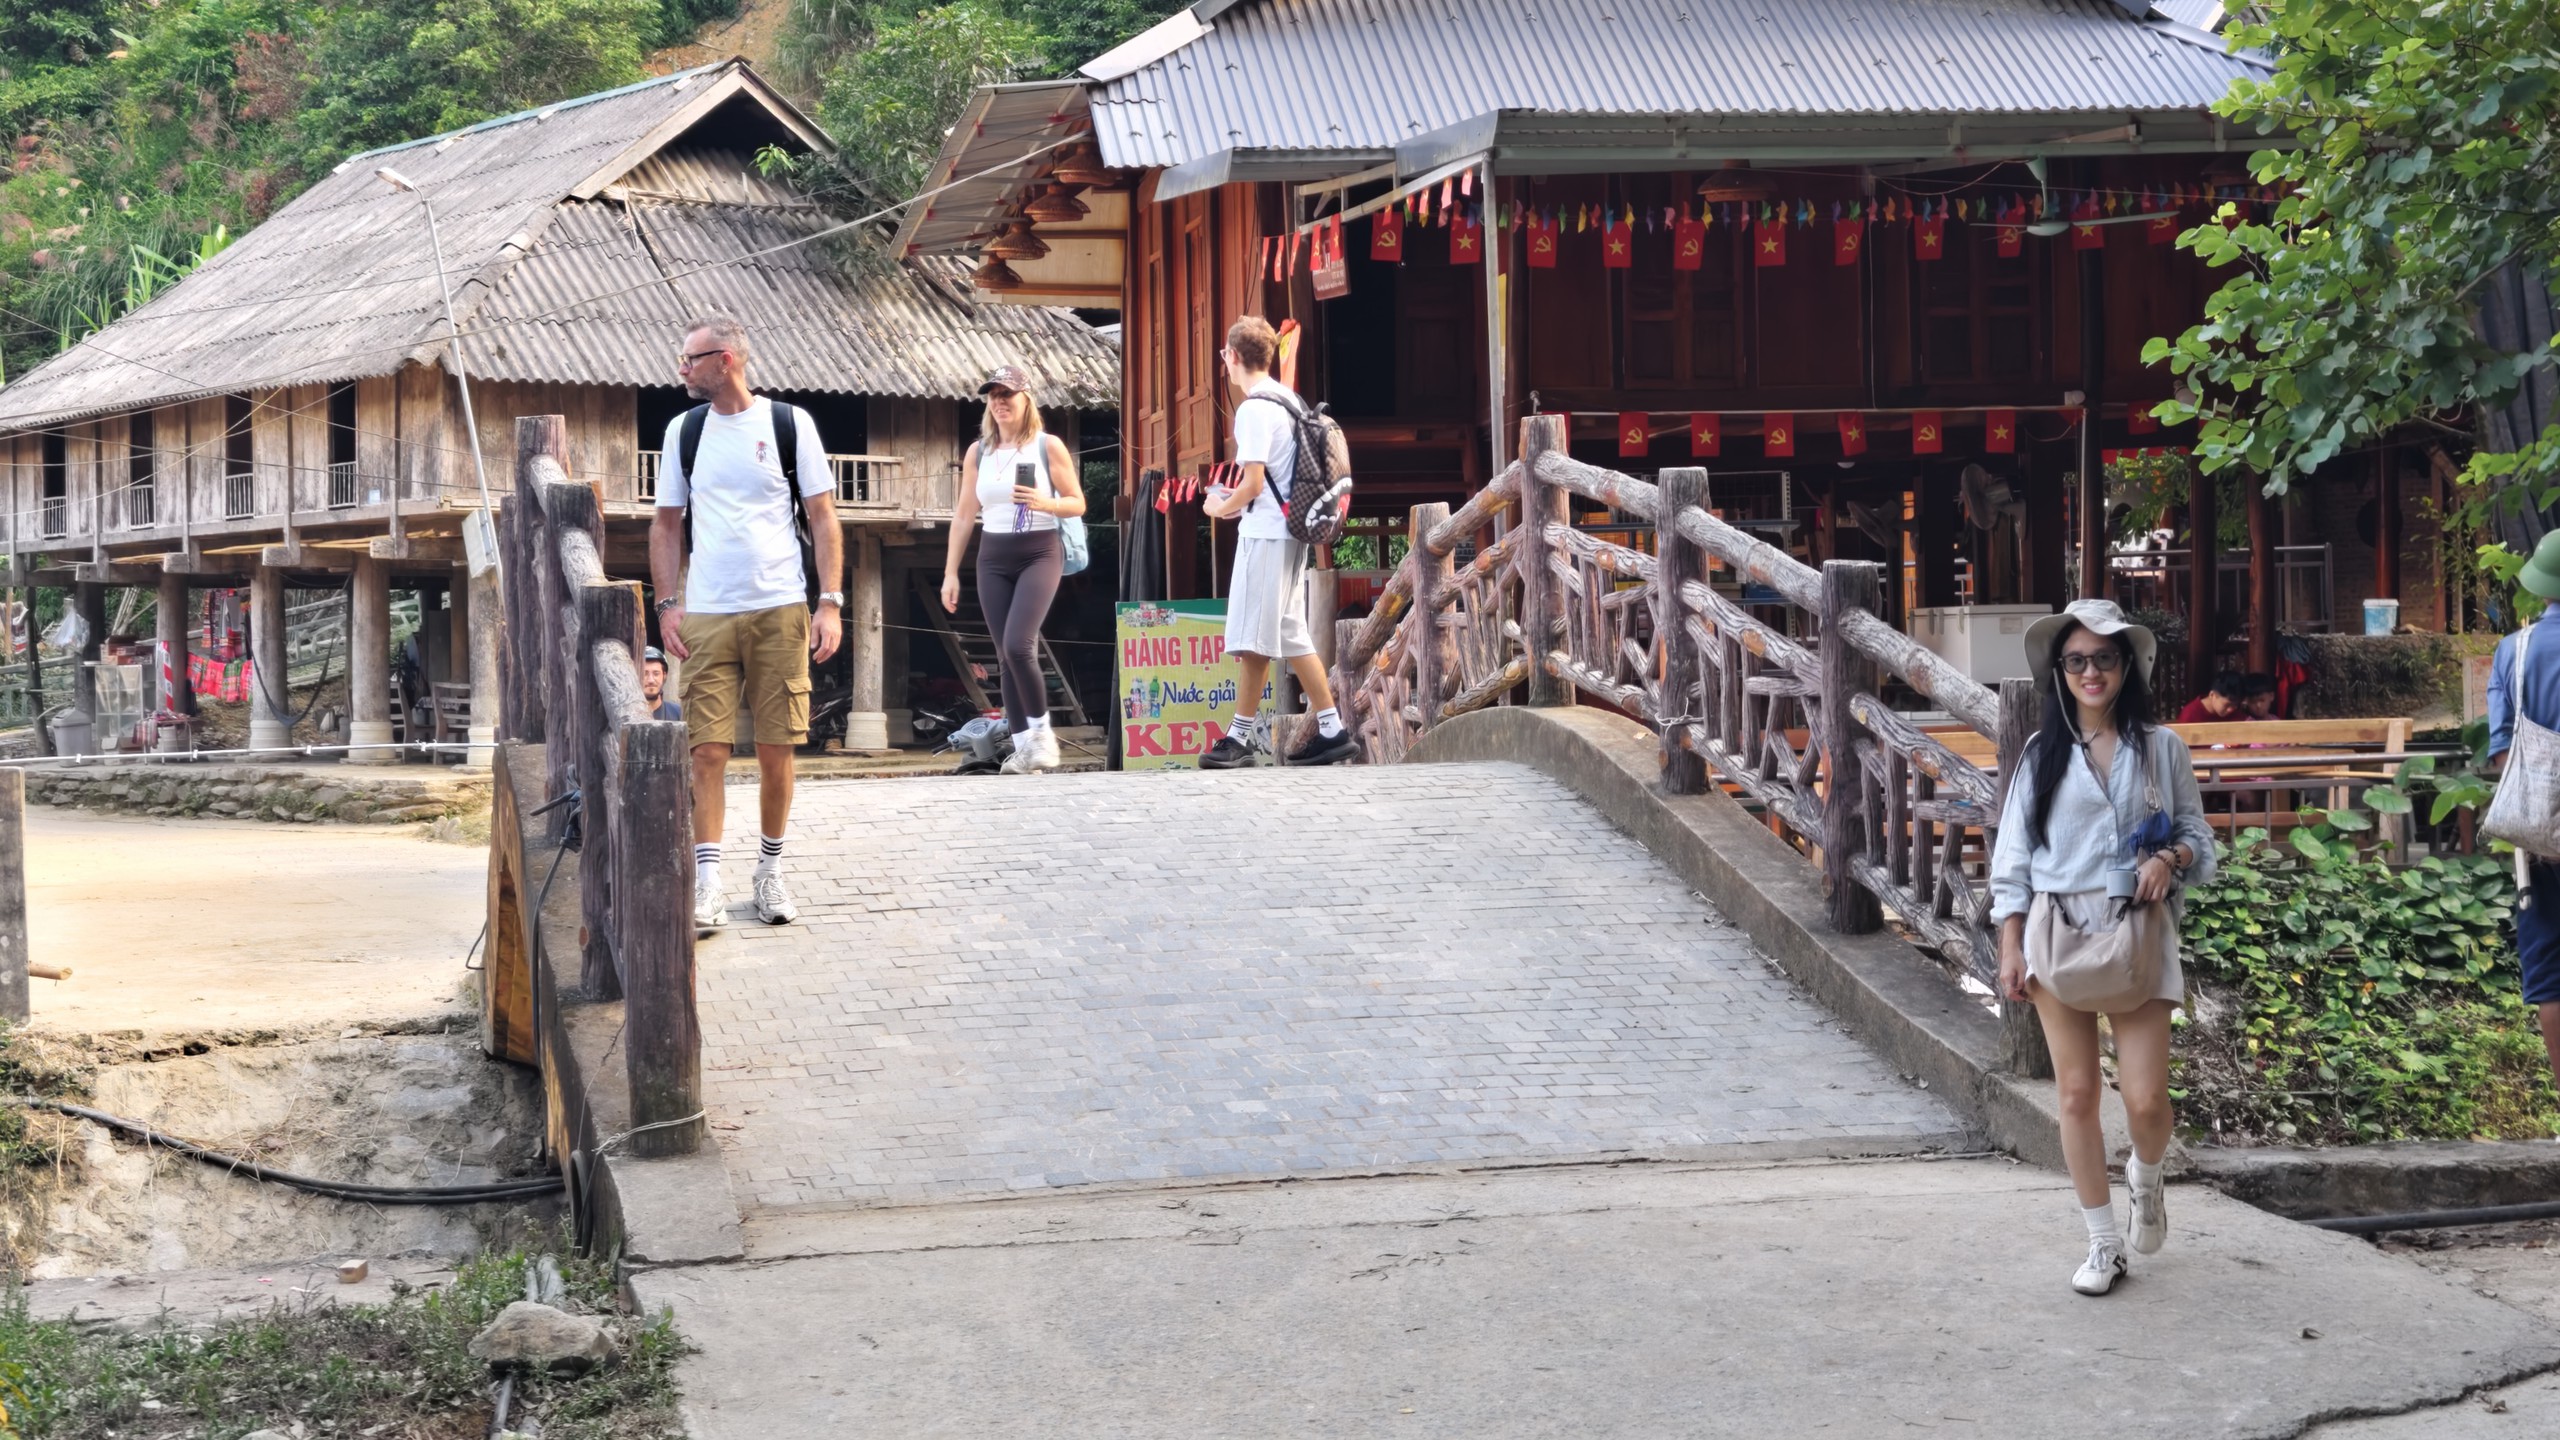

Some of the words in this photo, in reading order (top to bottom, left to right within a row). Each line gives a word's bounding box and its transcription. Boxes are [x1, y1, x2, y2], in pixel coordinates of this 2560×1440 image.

[1123, 632, 1182, 668] HÀNG
[1188, 635, 1226, 671] TẠP
[1161, 681, 1205, 708] Nước
[1208, 679, 1236, 710] giải
